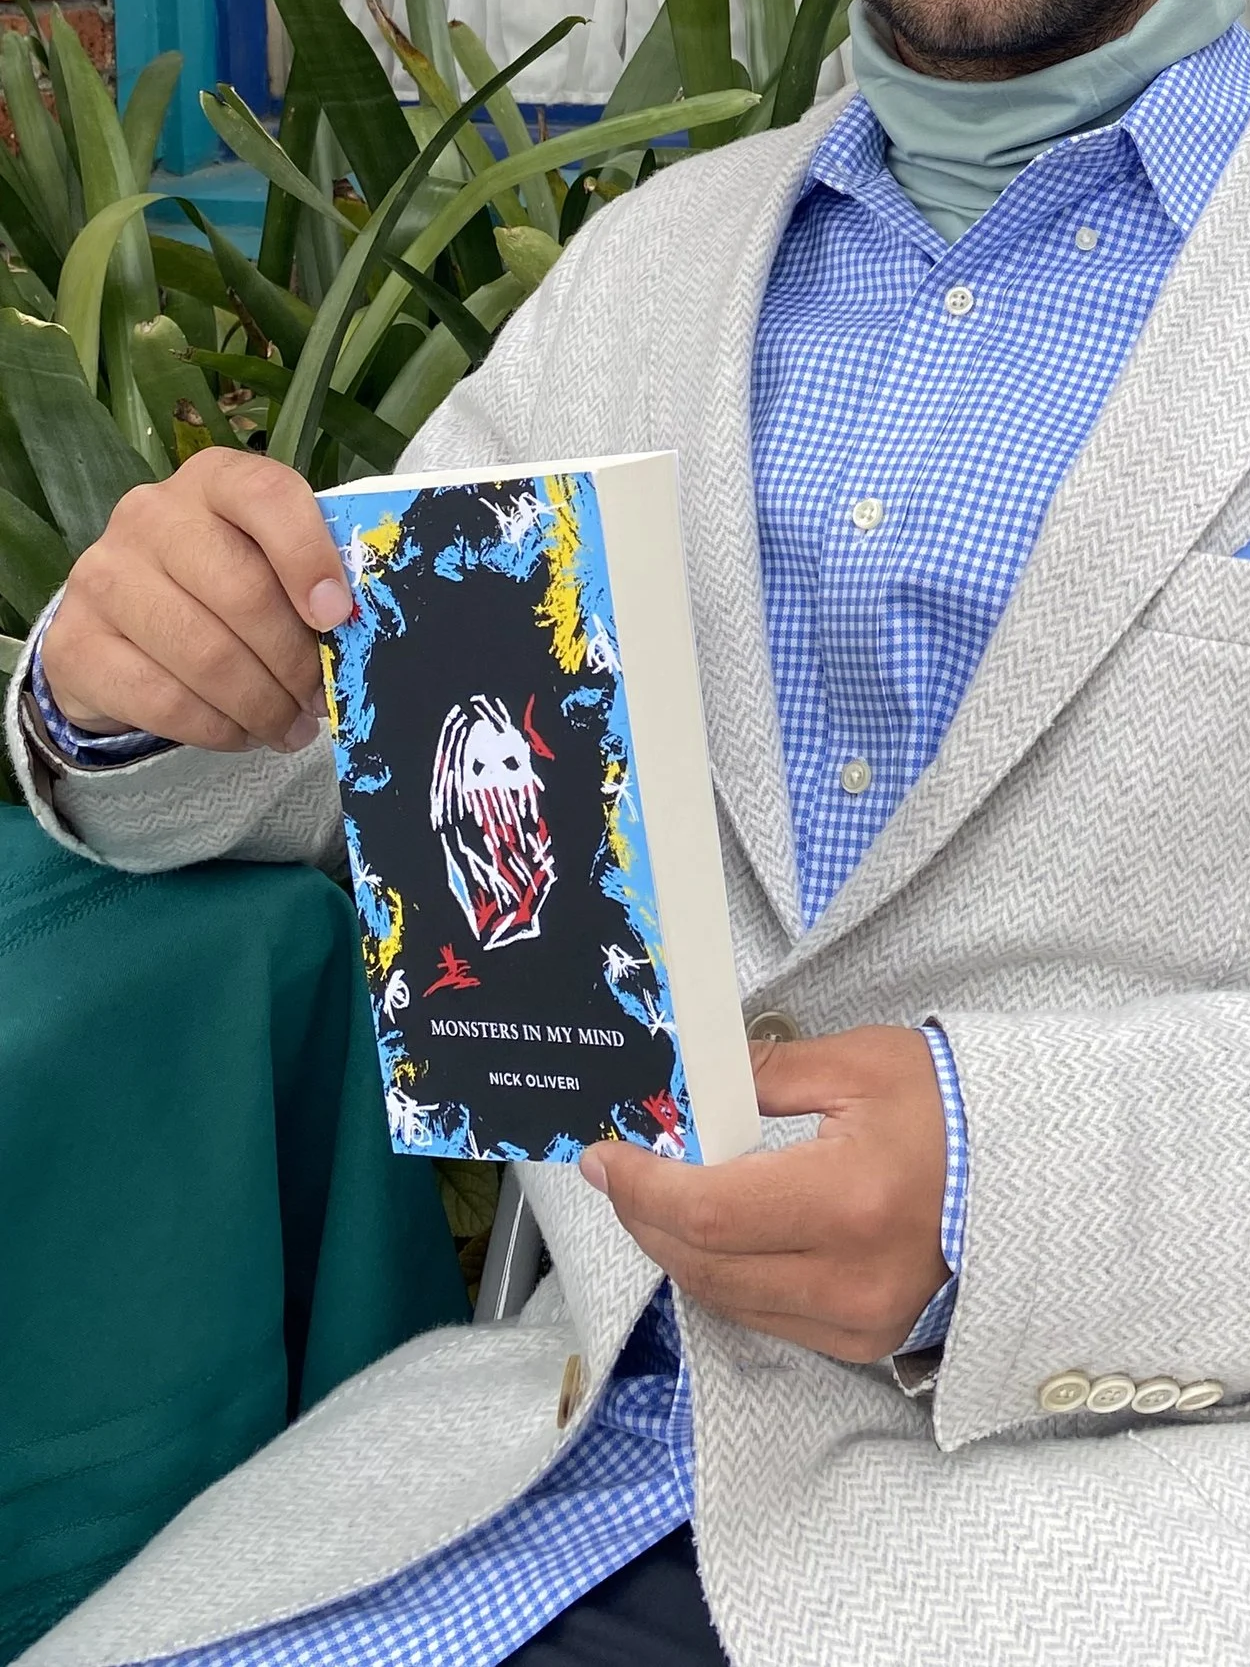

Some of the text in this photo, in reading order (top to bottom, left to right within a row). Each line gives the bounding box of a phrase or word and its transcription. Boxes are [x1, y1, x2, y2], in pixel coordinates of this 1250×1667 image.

[430, 1019, 626, 1047] MONSTERS IN MY MIND
[489, 1072, 581, 1091] NICK OLIVERI
